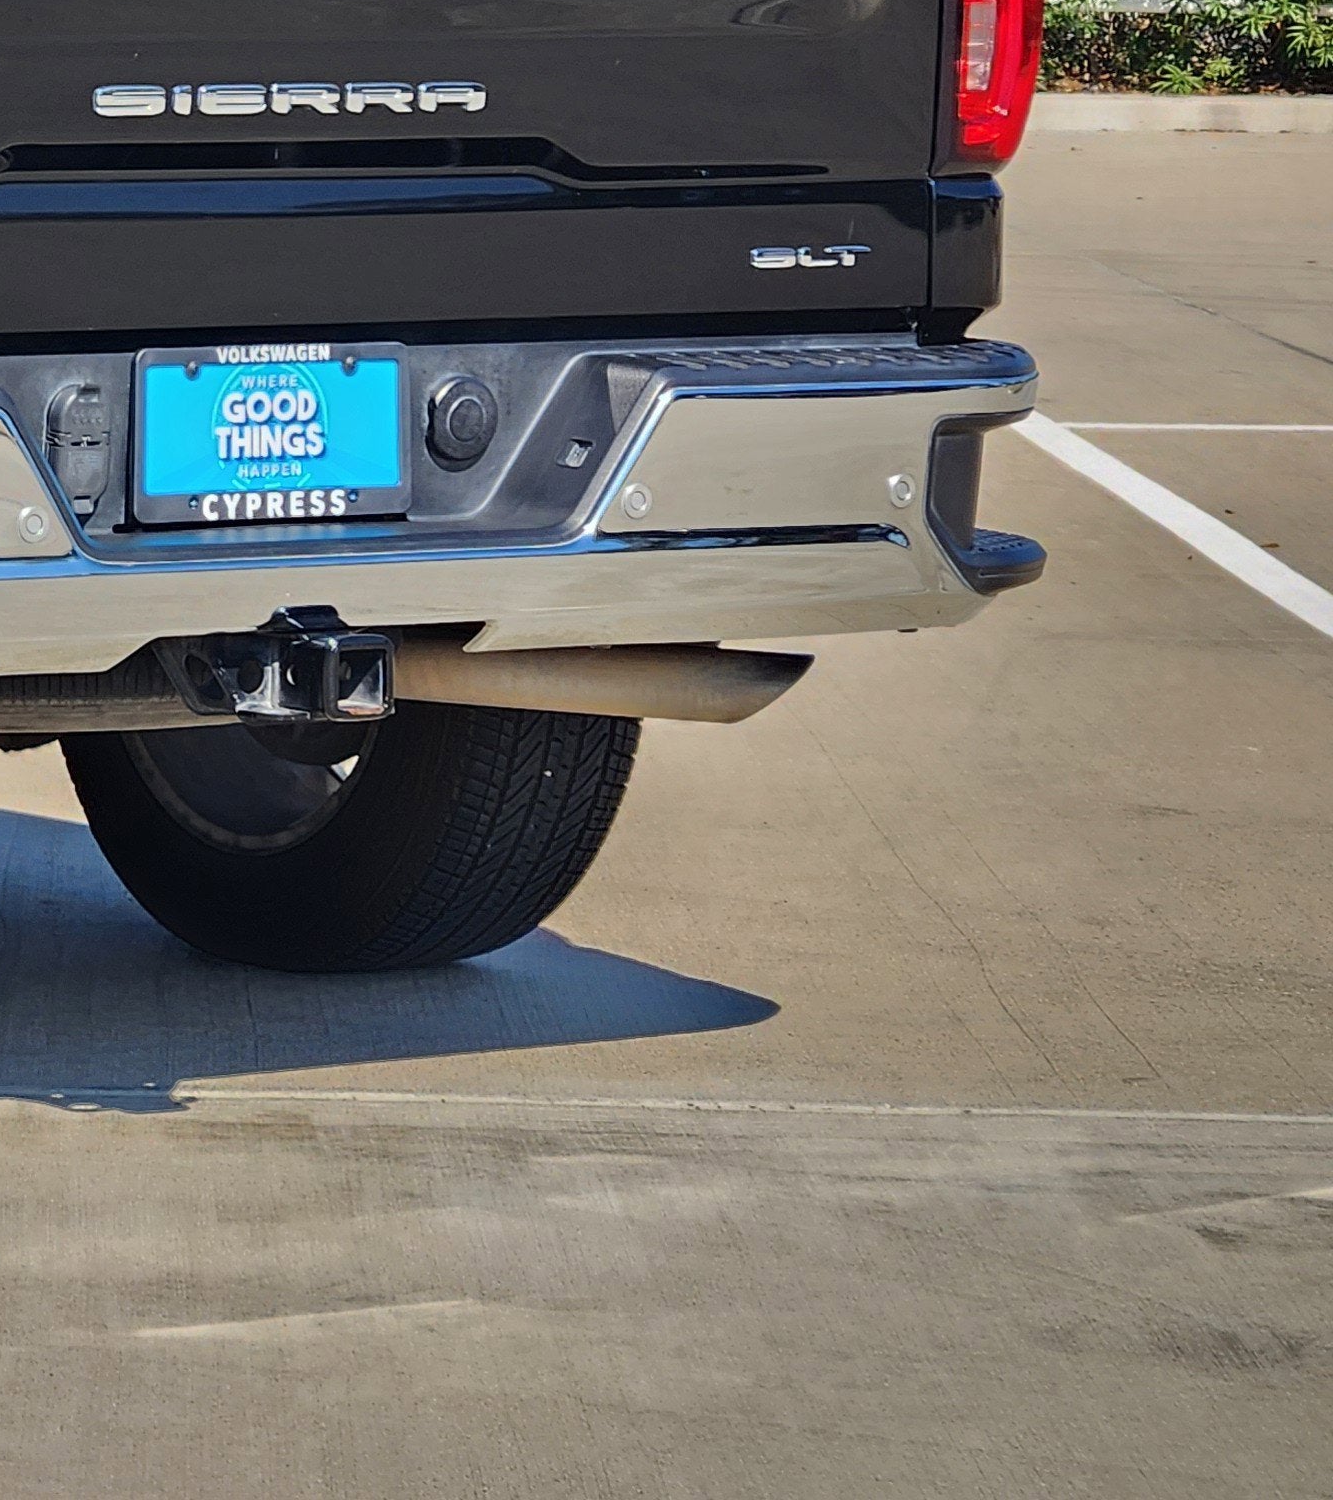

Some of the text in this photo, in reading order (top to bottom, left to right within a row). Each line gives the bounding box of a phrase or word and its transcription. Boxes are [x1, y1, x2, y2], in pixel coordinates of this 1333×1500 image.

[92, 81, 488, 117] SIERRA
[750, 245, 872, 269] SLT
[216, 344, 331, 364] VOLKSWAGEN
[241, 374, 299, 389] WHERE
[221, 390, 317, 422] GOOD
[214, 424, 326, 460] THINGS
[238, 463, 303, 479] HAPPEN
[201, 489, 347, 521] CYPRESS
